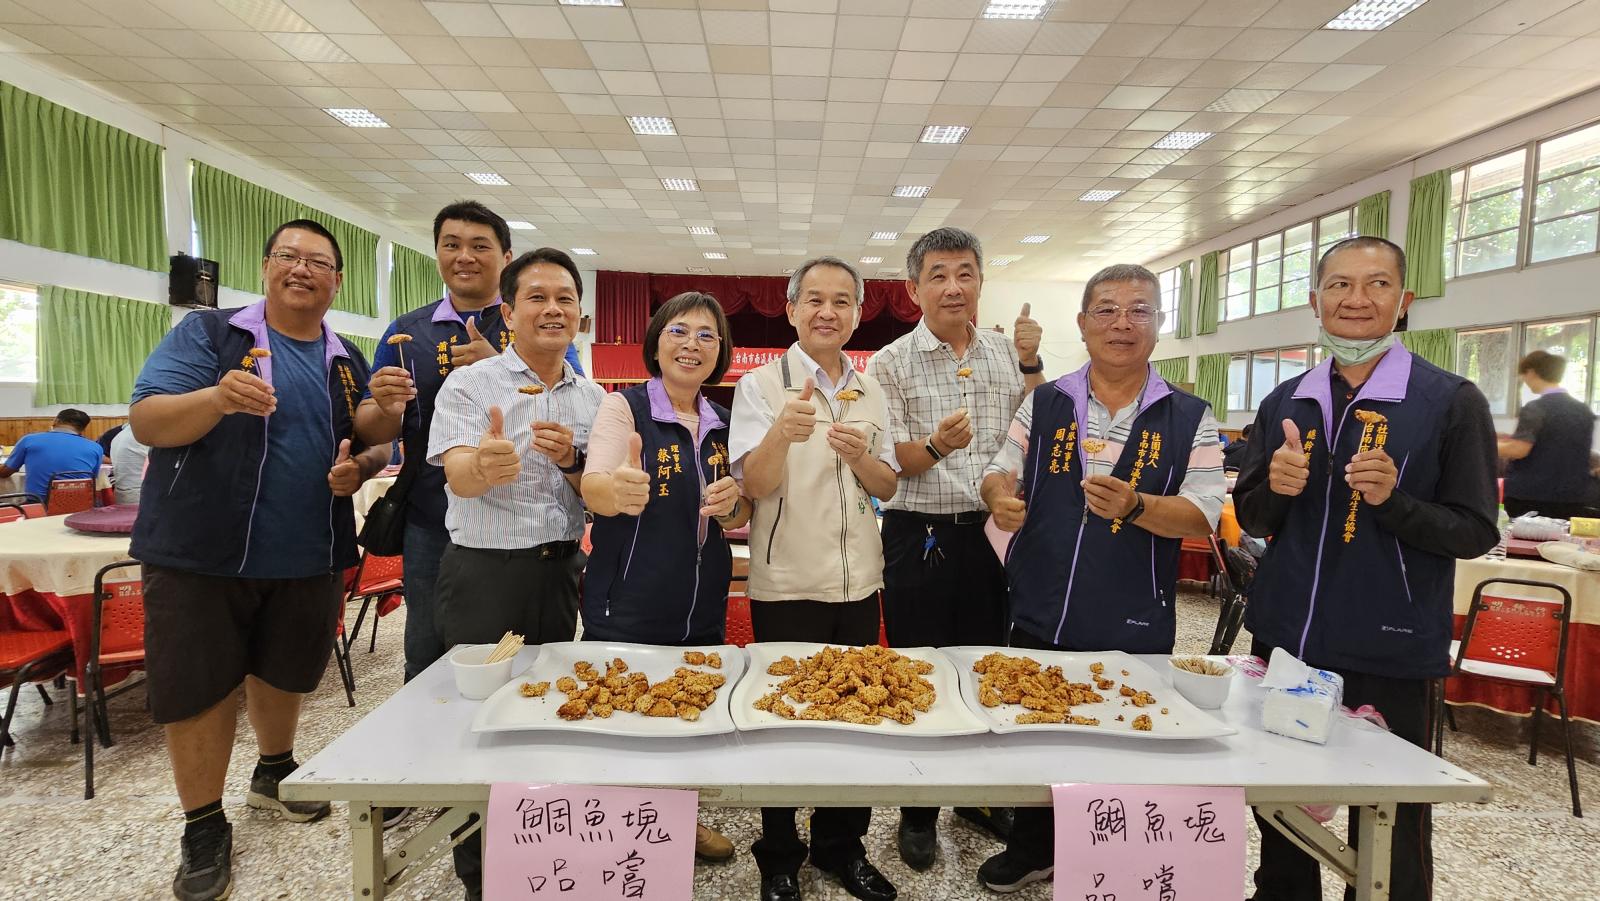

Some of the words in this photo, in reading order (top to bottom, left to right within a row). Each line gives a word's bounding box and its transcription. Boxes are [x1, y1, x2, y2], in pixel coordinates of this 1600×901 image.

[657, 448, 672, 497] 蔡阿玉
[671, 444, 682, 473] 理事長
[1049, 428, 1067, 474] 周志亮
[1146, 432, 1162, 468] 社團法人
[513, 798, 672, 845] 鯛魚塊
[1086, 798, 1226, 845] 鯛魚塊
